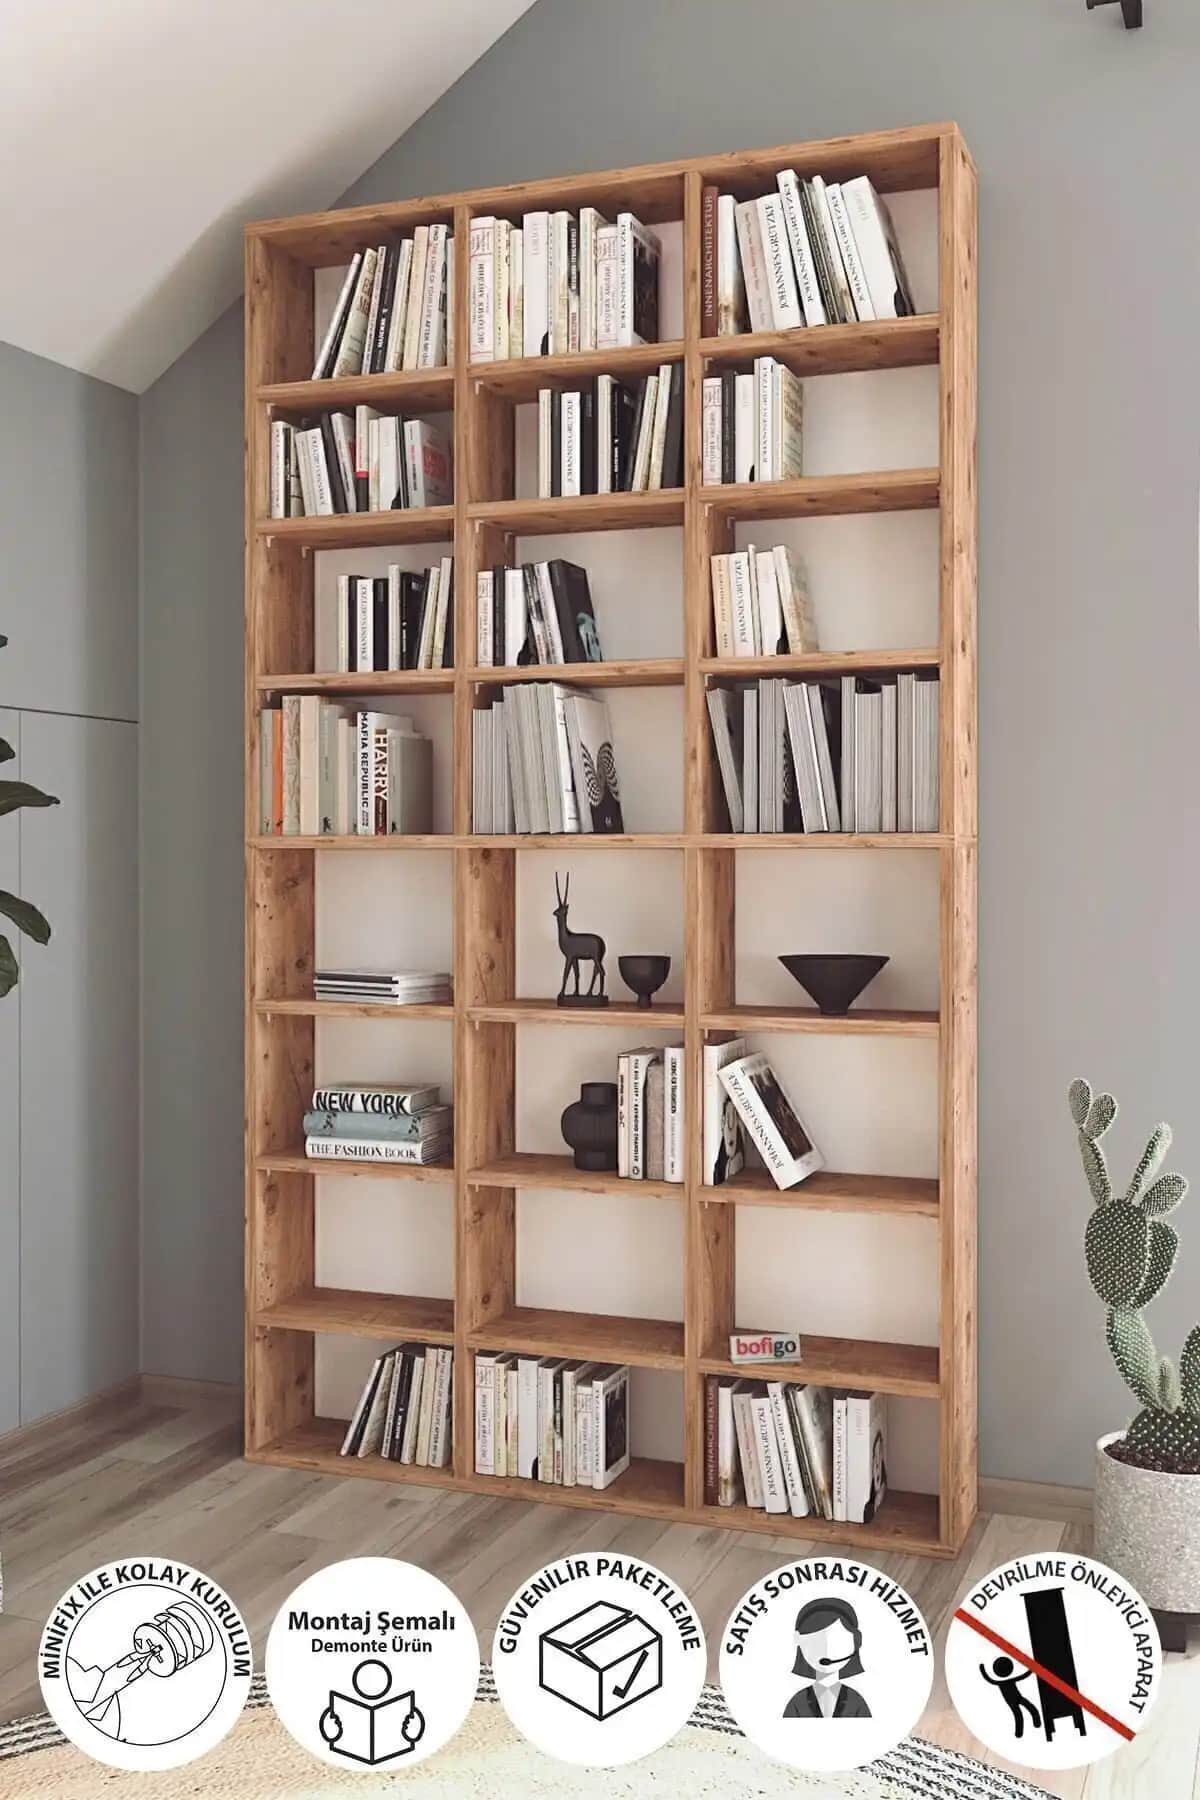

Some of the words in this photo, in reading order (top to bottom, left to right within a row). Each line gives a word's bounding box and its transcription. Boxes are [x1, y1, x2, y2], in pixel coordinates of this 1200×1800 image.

[704, 193, 713, 317] INNENARCHITEKTUR
[361, 712, 369, 749] MAFIA
[361, 752, 369, 808] REPUBLIC
[374, 734, 389, 800] HARRY
[315, 1091, 356, 1112] NEW
[360, 1093, 411, 1116] YORK
[309, 1143, 333, 1155] THE
[334, 1143, 383, 1157] FASHION
[385, 1147, 417, 1159] BOOK
[736, 1337, 797, 1358] bofigo
